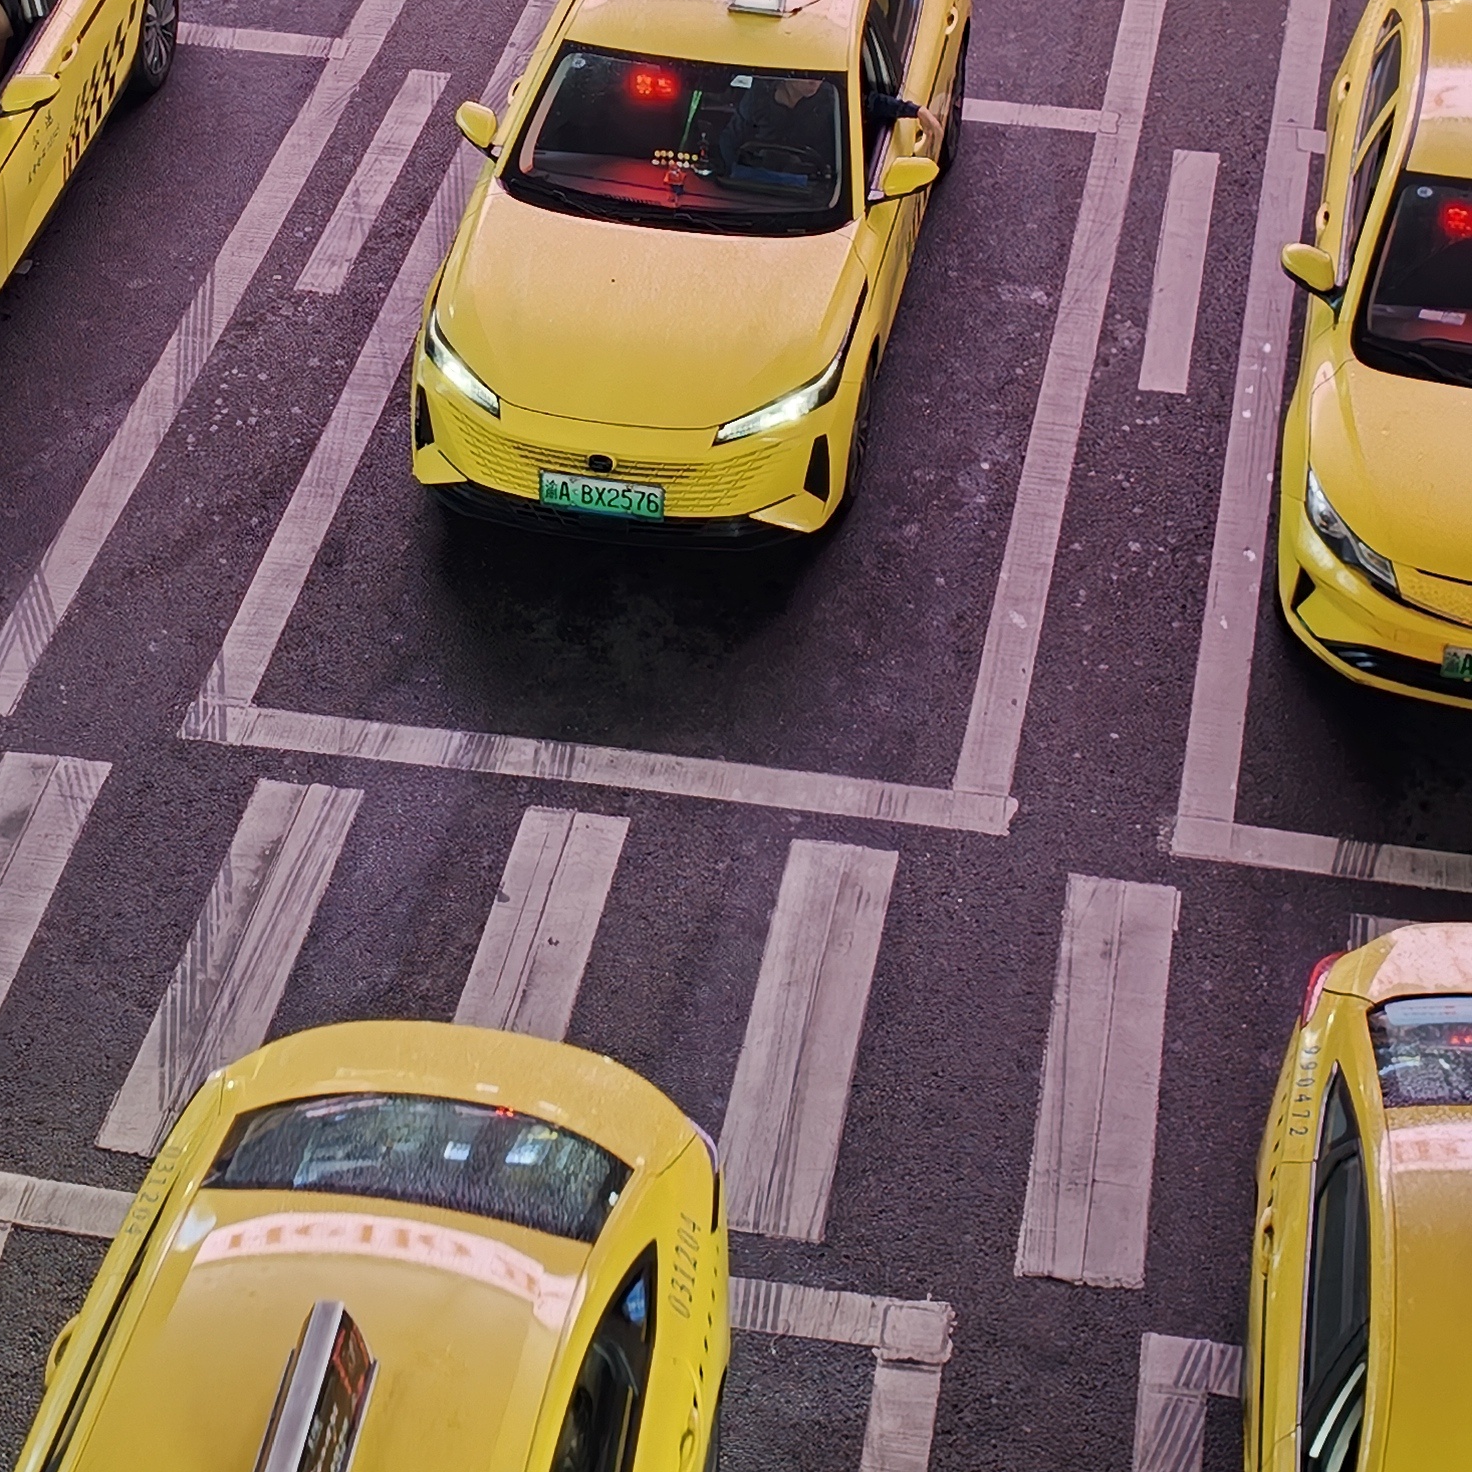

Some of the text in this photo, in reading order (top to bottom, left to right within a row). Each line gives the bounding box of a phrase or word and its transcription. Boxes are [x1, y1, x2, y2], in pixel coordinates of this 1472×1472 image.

[581, 484, 659, 514] BX2576
[1289, 1044, 1322, 1147] 990472
[668, 1211, 702, 1320] 031204
